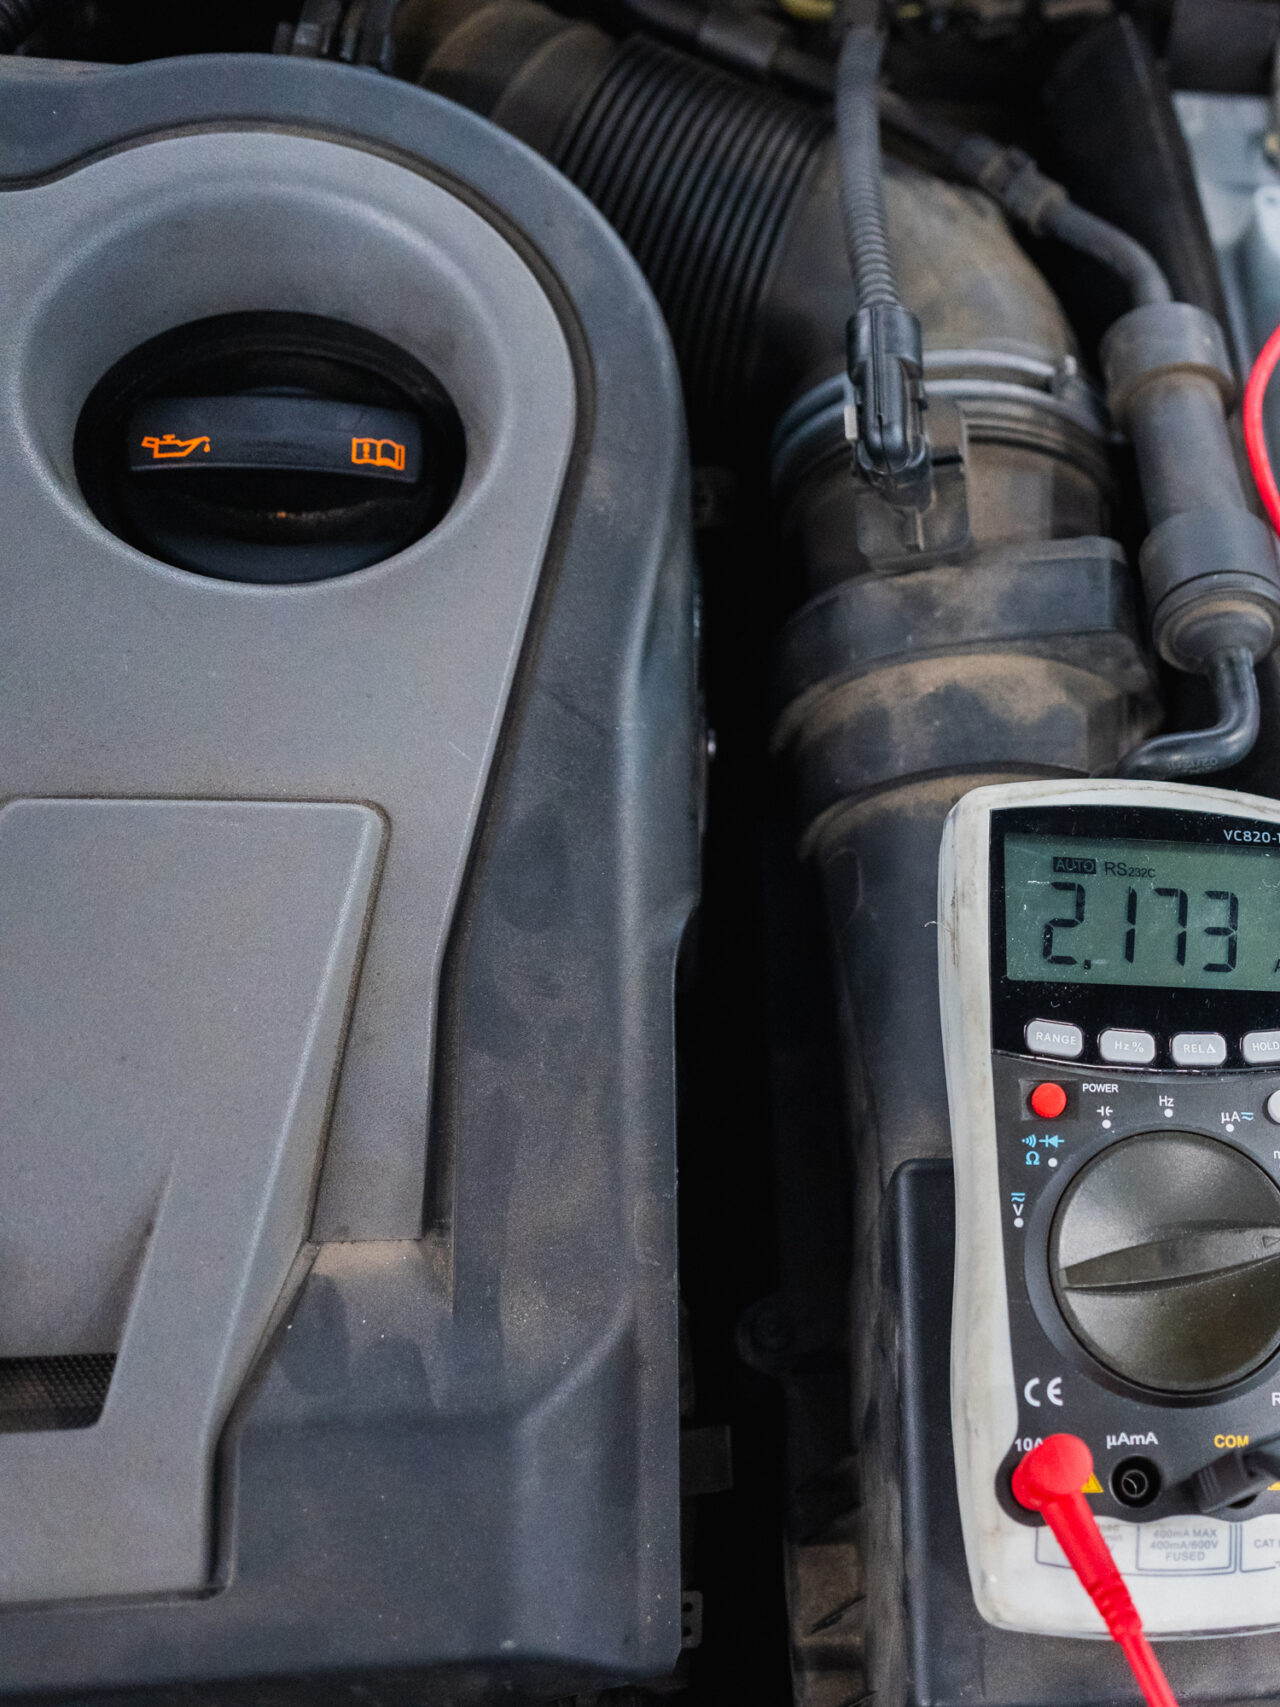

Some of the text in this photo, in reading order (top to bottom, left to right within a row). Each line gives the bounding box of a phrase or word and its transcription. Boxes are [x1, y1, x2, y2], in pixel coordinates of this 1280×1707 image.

[1053, 857, 1096, 874] AUTO
[1042, 881, 1239, 973] 2.173
[1036, 1031, 1077, 1045] RANGE
[1082, 1083, 1119, 1094] POWER
[1158, 1095, 1175, 1107] Hz
[1012, 1203, 1024, 1217] V
[1024, 1376, 1064, 1407] CE
[1213, 1433, 1250, 1449] COM
[1193, 1529, 1217, 1538] MAX
[1253, 1538, 1275, 1549] CAT
[1165, 1551, 1206, 1562] FUSED
